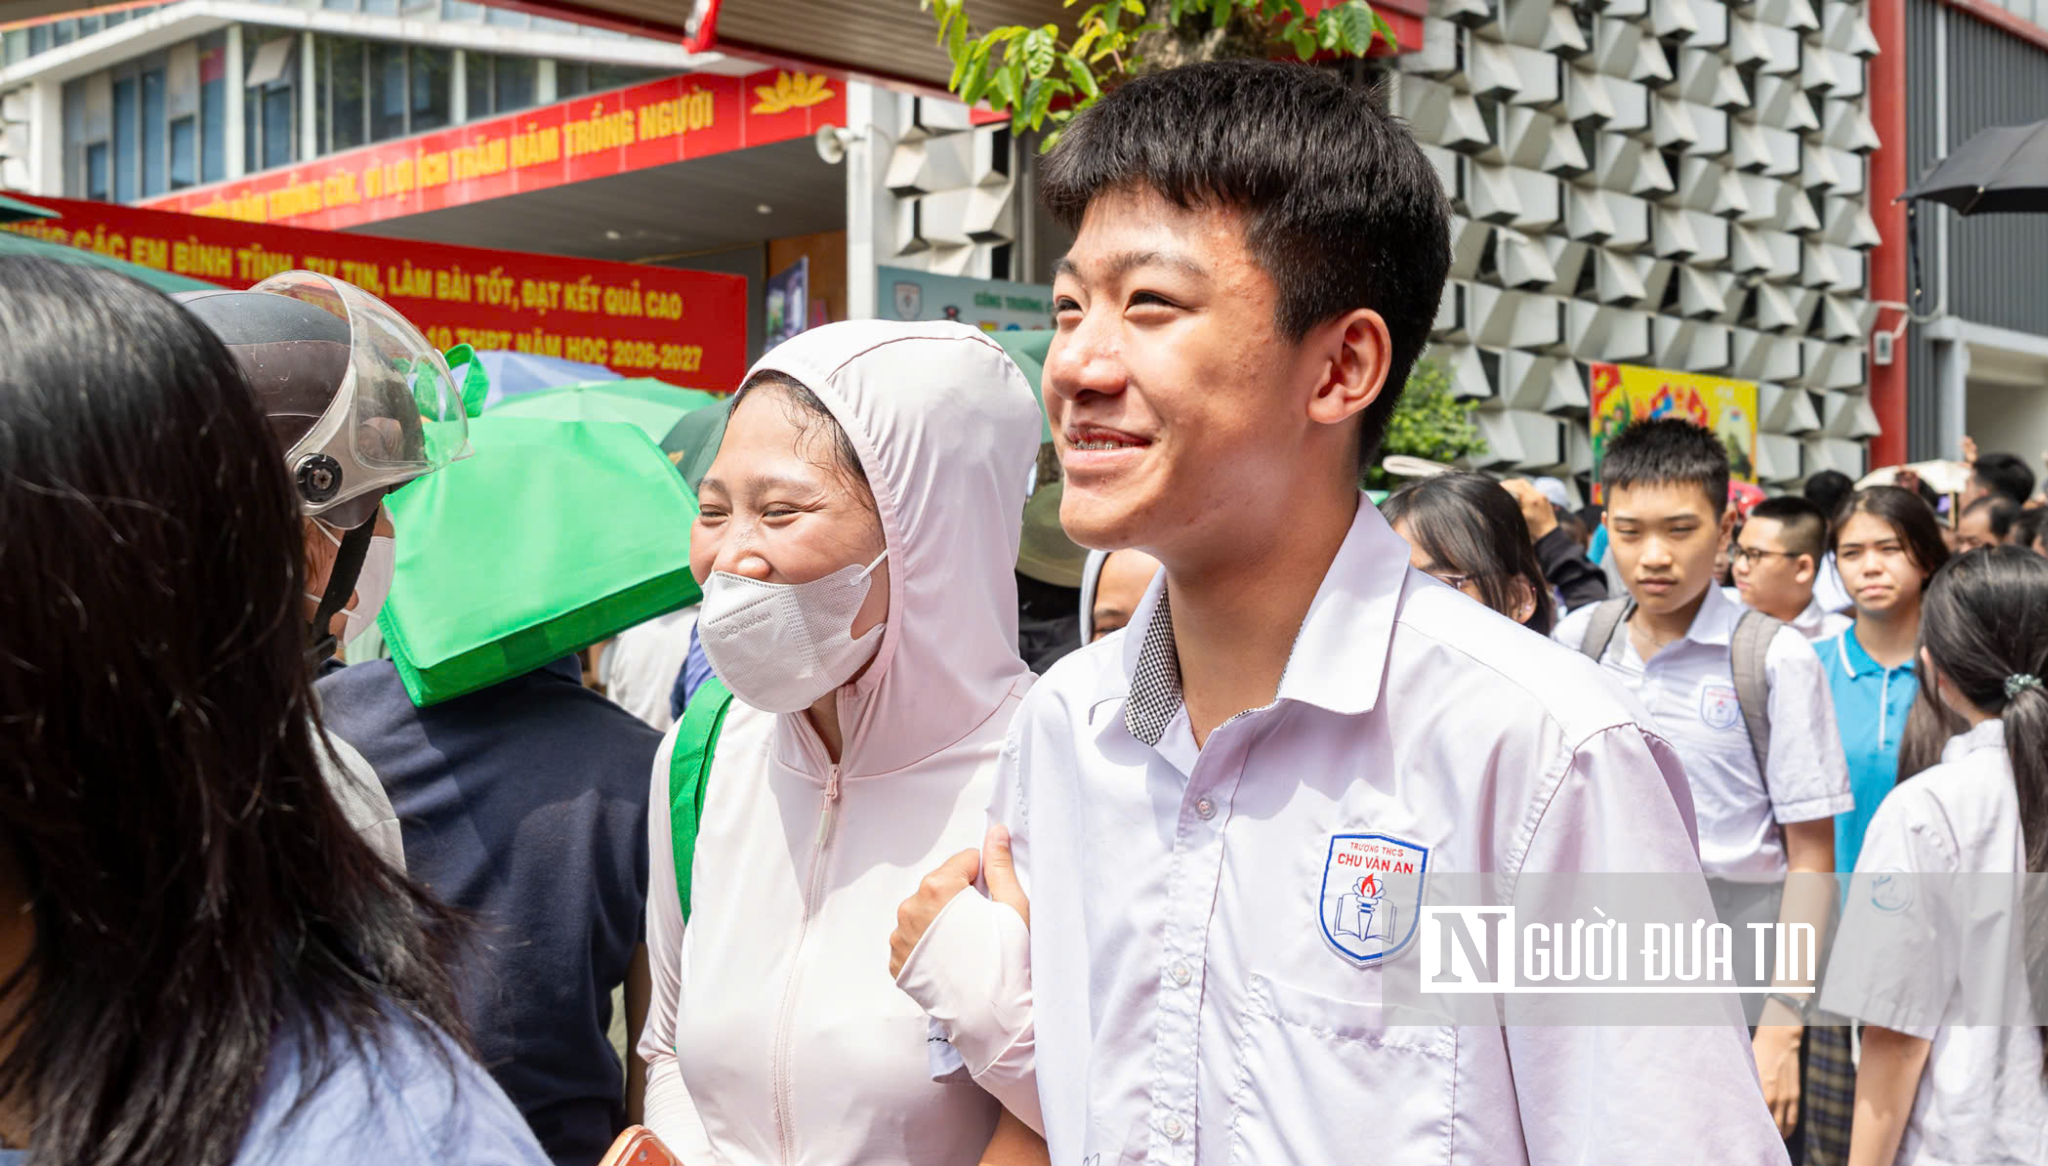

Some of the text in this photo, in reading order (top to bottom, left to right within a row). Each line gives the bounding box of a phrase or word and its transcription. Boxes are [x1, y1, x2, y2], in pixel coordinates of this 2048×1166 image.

[451, 134, 507, 181] TRĂM
[510, 122, 559, 168] NĂM
[563, 101, 635, 157] TRỒNG
[639, 85, 714, 140] NGƯỜI
[131, 236, 168, 271] EM
[173, 235, 233, 277] BÌNH
[388, 259, 432, 297] LÀM
[436, 266, 471, 301] BÀI
[474, 267, 519, 311] TỐT,
[521, 279, 561, 315] ĐẠT
[564, 275, 602, 312] KẾT
[604, 280, 642, 318] QUẢ
[645, 290, 683, 320] CAO
[427, 326, 451, 353] 10
[516, 328, 562, 359] NĂM
[612, 340, 703, 372] 2026-2027
[1338, 853, 1414, 875] CHU VĂN AN
[1382, 847, 1404, 857] THCS
